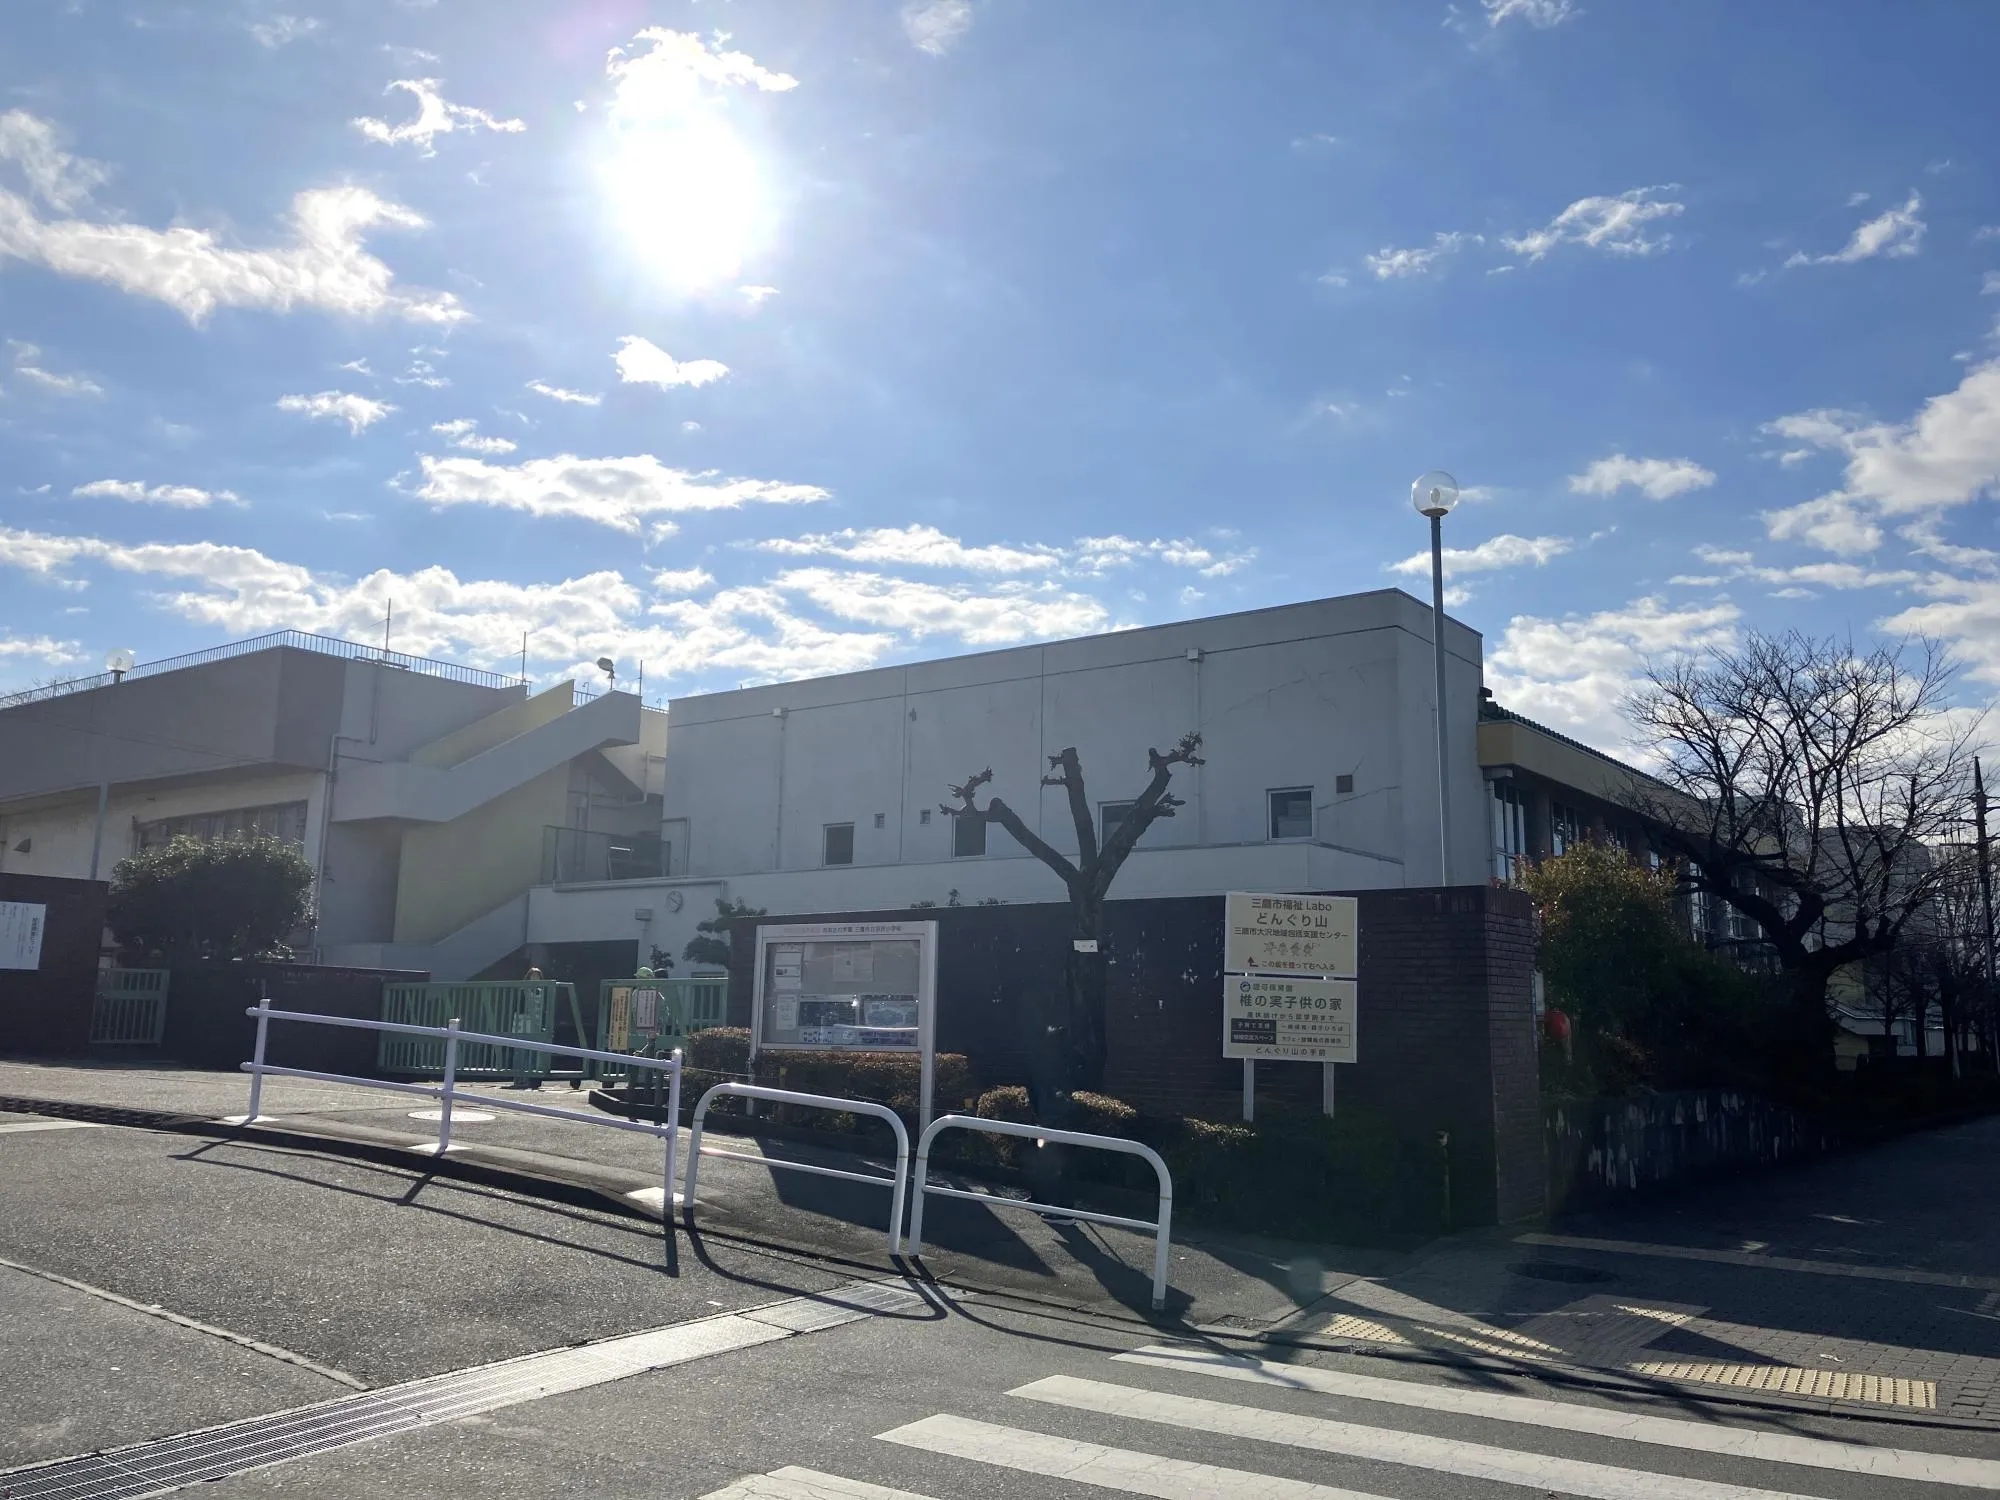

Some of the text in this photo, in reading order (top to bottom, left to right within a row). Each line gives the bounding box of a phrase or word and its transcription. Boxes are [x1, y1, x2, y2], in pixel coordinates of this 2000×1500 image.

[1251, 898, 1332, 911] 三鷹市福祉 Labo
[1256, 912, 1328, 928] どんぐり山
[1233, 926, 1349, 940] 三鷹市大沢地域包括支援センター
[1239, 993, 1342, 1011] 椎の実子供の家
[1255, 1046, 1327, 1057] どんぐり山の手前
